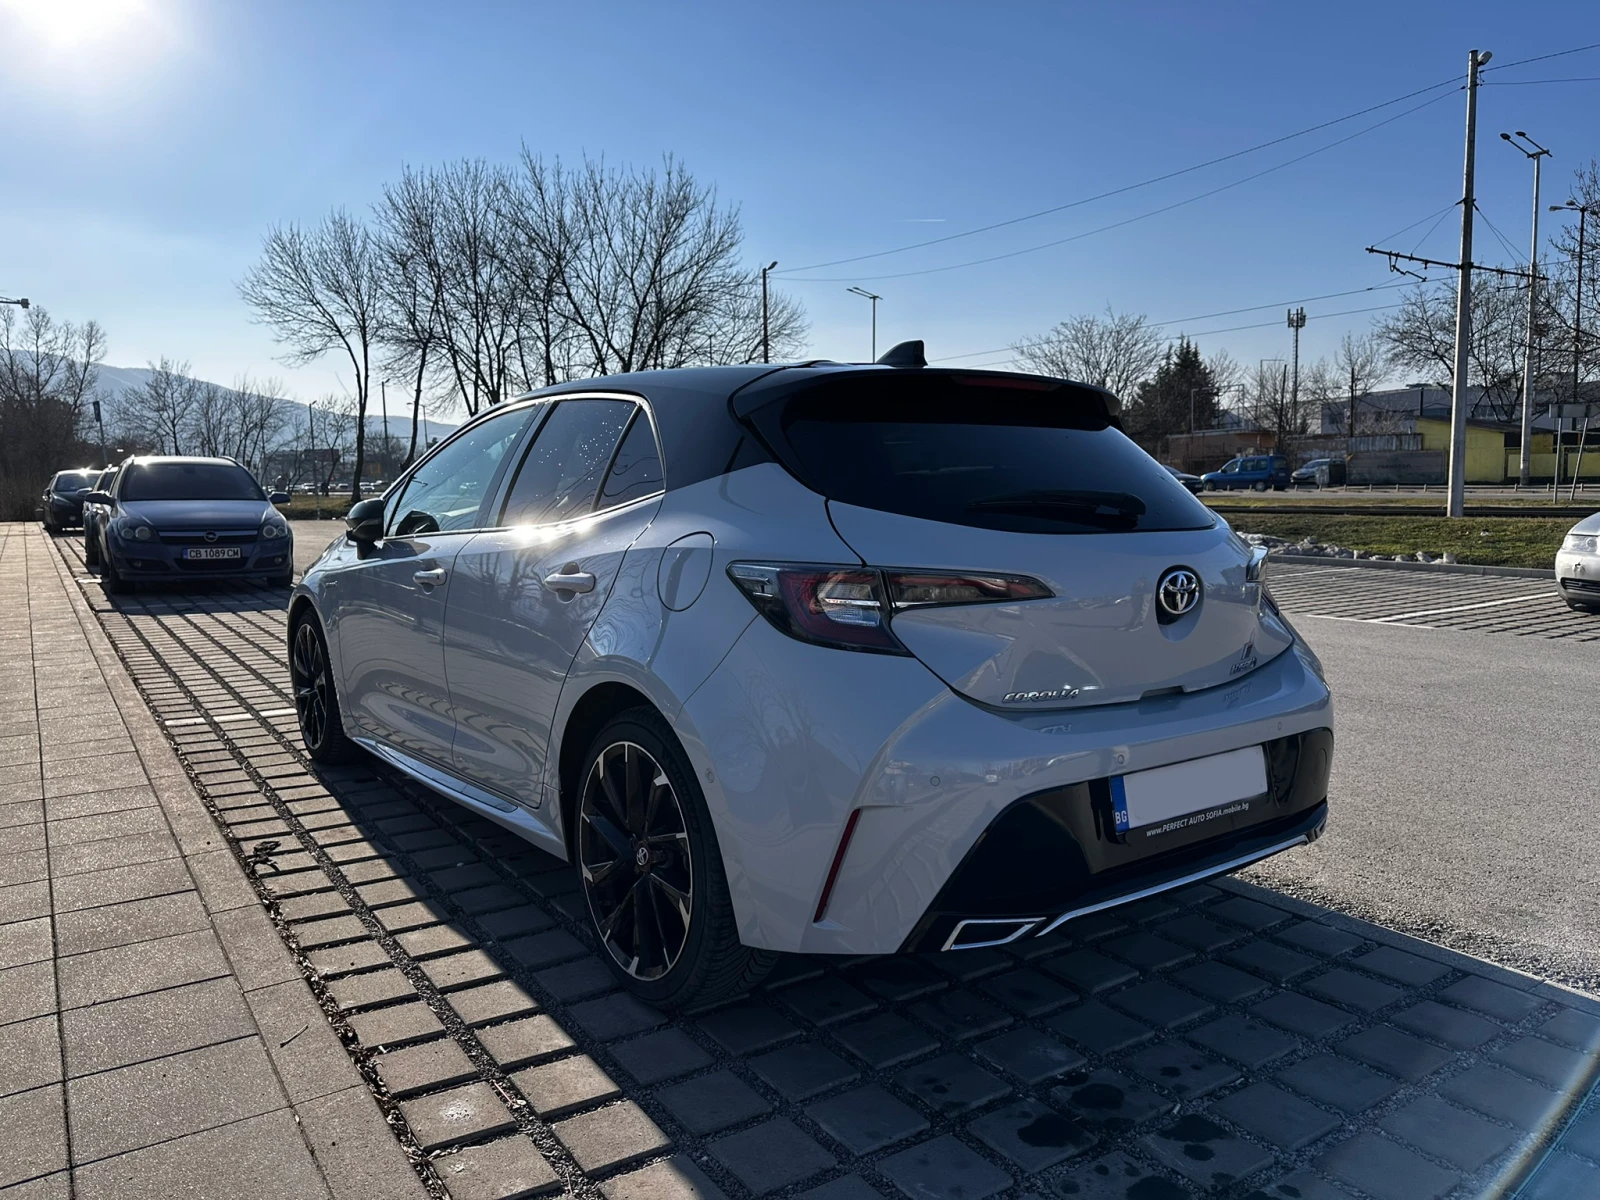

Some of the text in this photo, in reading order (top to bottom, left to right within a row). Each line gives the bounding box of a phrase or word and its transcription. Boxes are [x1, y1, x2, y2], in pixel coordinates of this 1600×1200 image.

[189, 548, 239, 559] CB 1089 CM
[1002, 688, 1080, 704] COROLLA
[1115, 810, 1128, 824] BG
[1146, 802, 1249, 837] www.PERFECT AUTO SOFIA.mobile.bg
